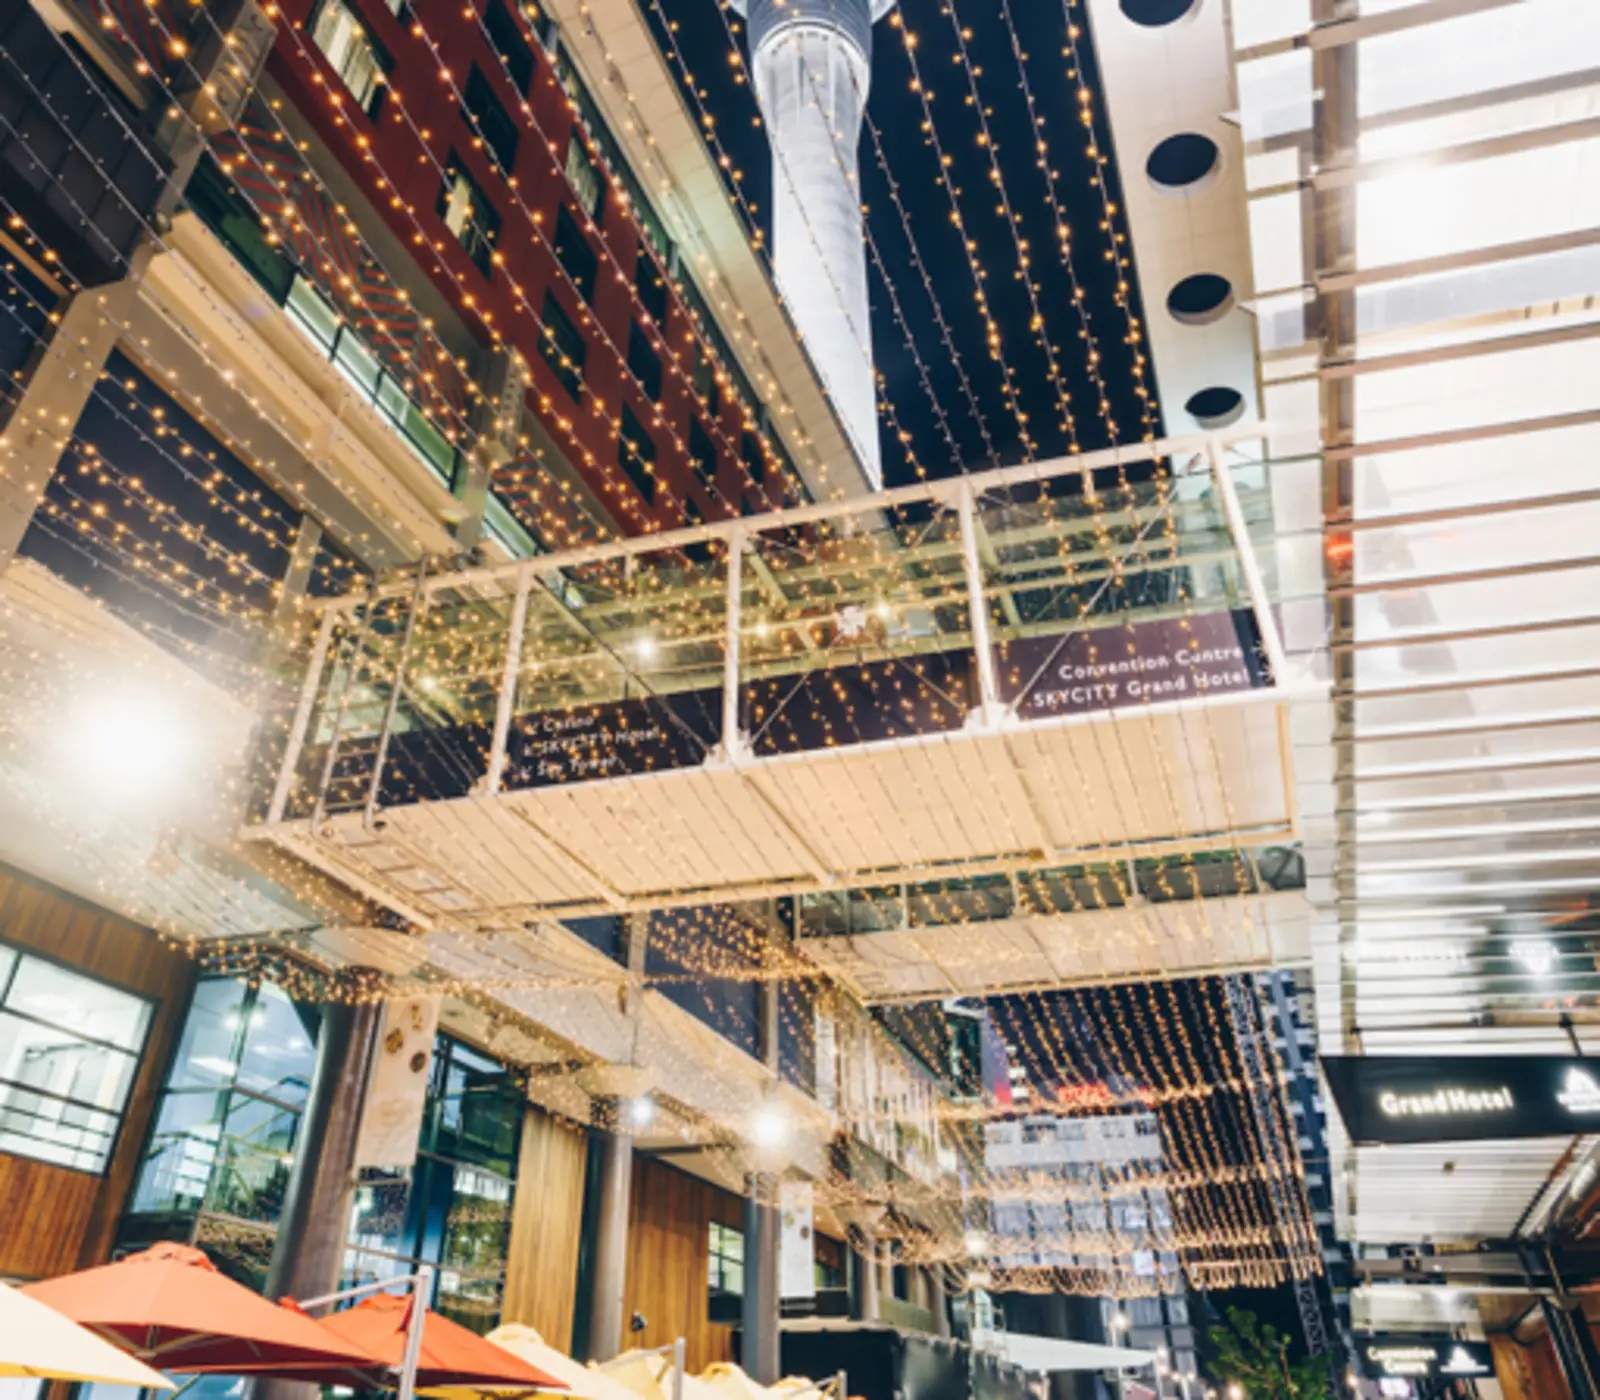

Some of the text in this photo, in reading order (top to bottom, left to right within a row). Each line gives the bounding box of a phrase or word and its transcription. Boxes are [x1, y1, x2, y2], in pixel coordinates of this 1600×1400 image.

[1059, 655, 1170, 680] Convention
[1033, 668, 1250, 708] SKYCITY Grand Hotel
[1379, 1087, 1513, 1116] Grand Hotel
